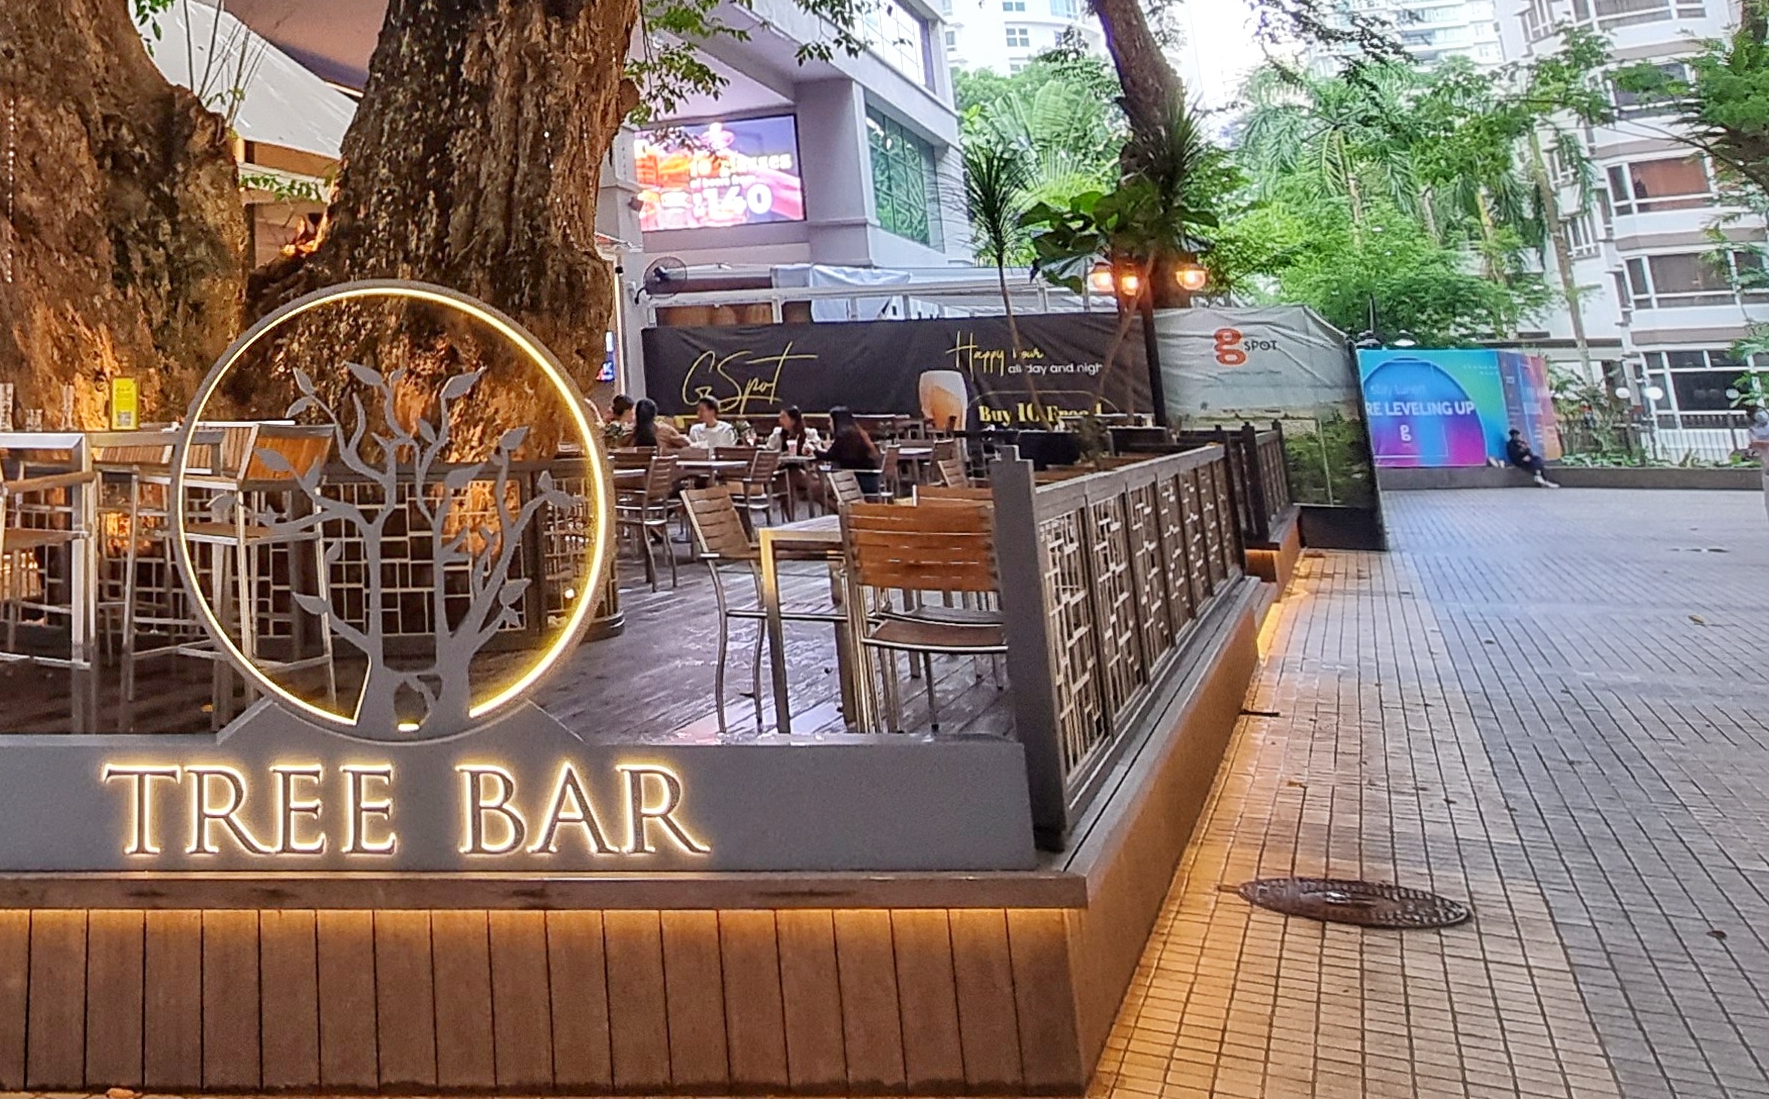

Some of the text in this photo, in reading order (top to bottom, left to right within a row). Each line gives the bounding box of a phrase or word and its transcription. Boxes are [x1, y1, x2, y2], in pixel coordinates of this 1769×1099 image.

[1244, 340, 1278, 351] SPOT
[946, 331, 1005, 382] Happy
[1008, 362, 1104, 376] all day and nigh
[978, 405, 1011, 427] Buy
[1385, 401, 1453, 416] LEVELING
[1455, 401, 1475, 415] UP
[101, 761, 712, 857] TREE BAR
